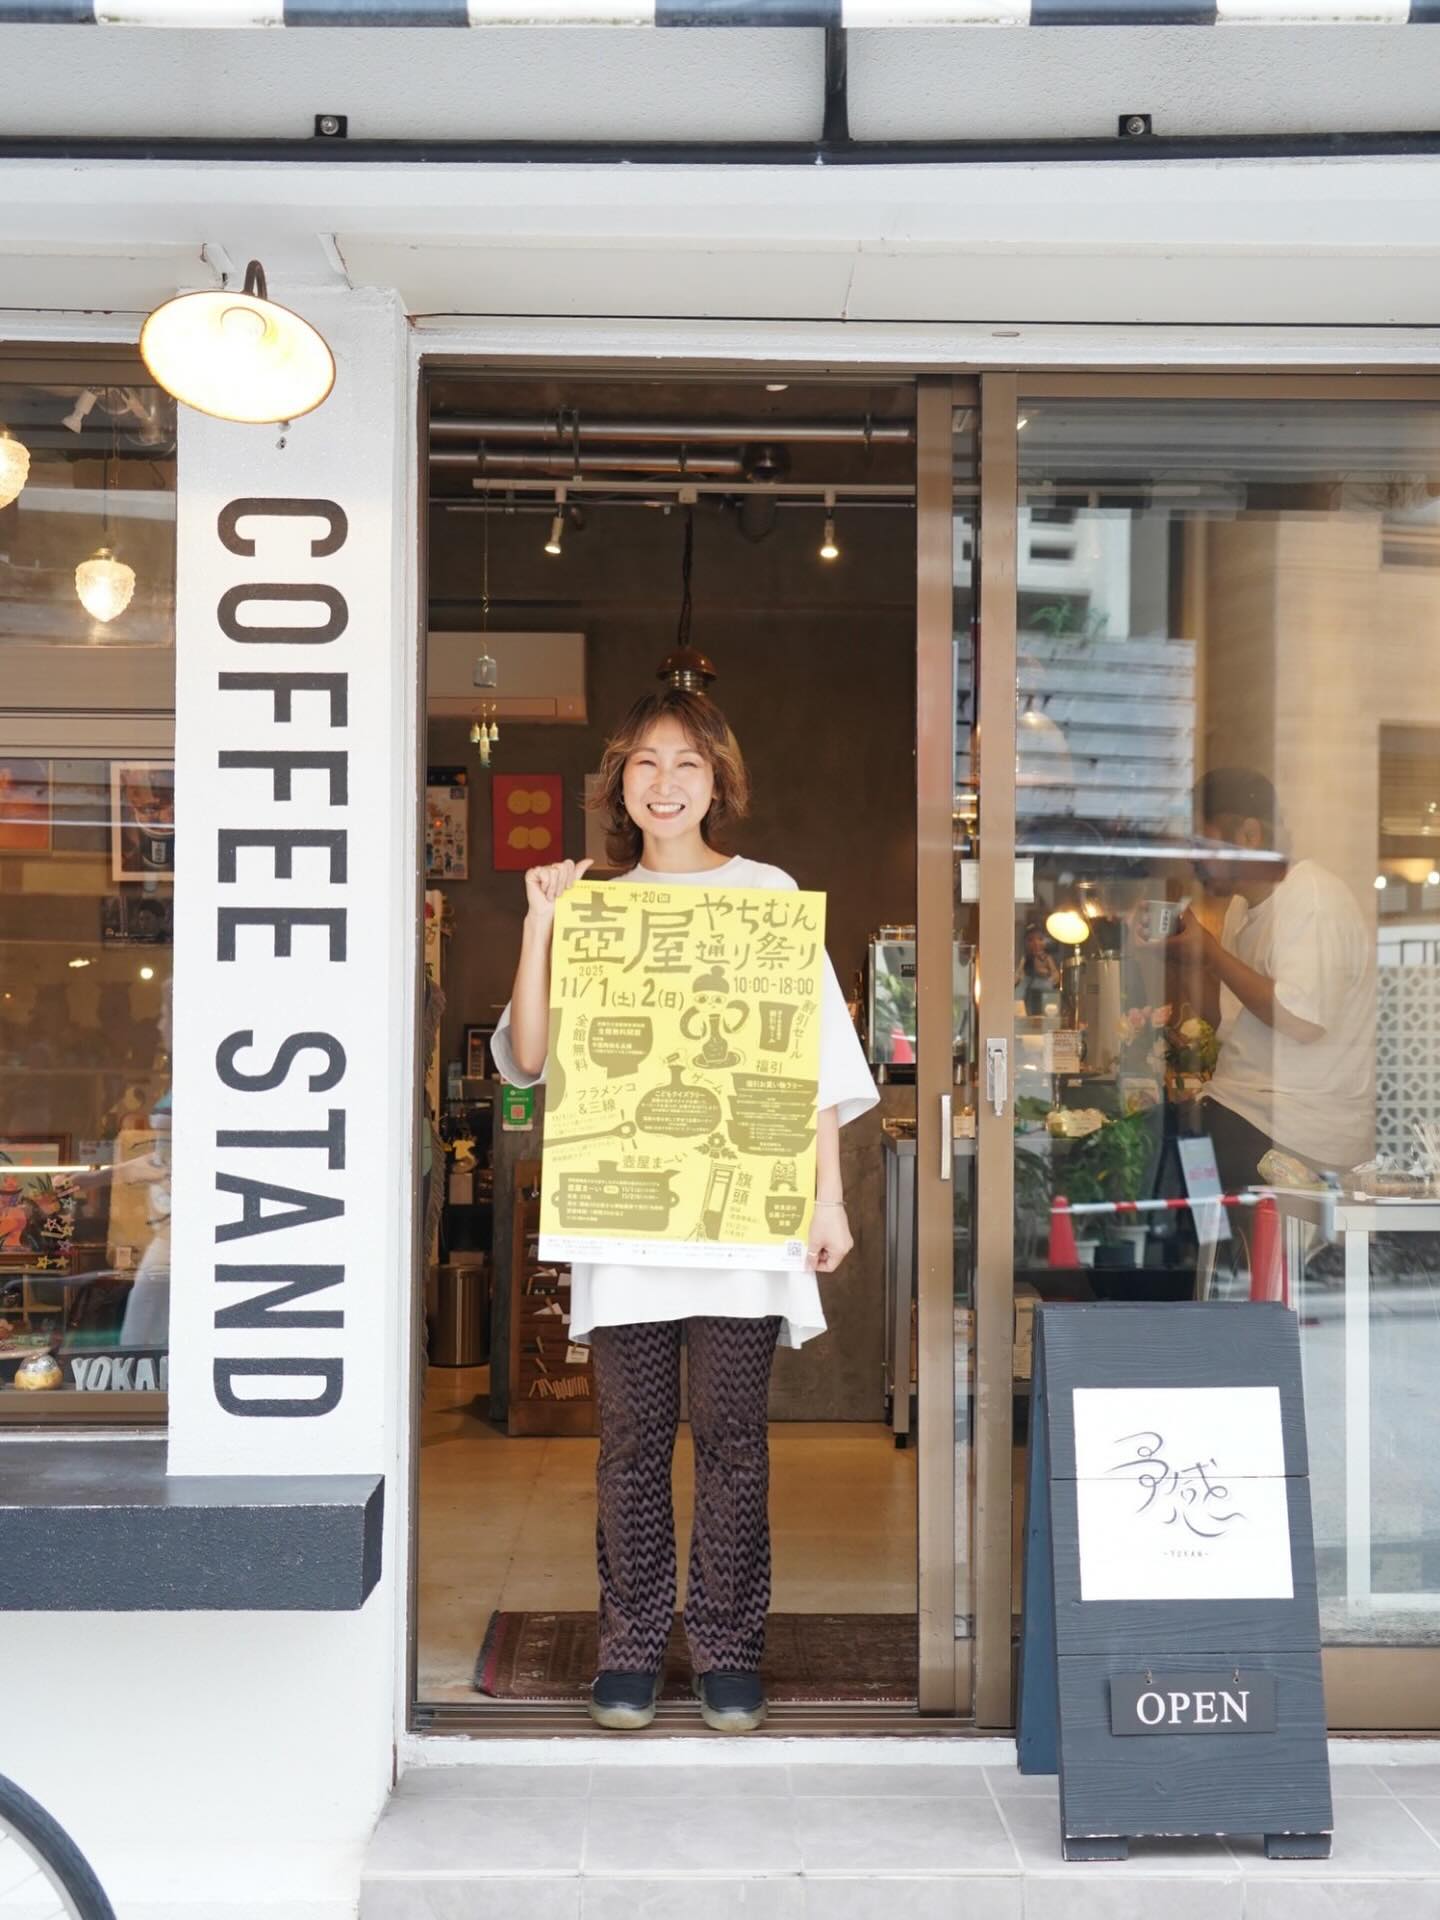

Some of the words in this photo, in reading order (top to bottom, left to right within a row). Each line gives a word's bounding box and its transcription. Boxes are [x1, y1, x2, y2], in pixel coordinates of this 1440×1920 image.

[217, 497, 349, 962] COFFEE
[696, 893, 818, 935] やちむん
[696, 932, 818, 971] 通り祭り
[579, 966, 604, 977] 2025
[576, 1084, 637, 1101] フラメンコ
[214, 1030, 348, 1418] STAND
[1136, 1691, 1250, 1725] OPEN
